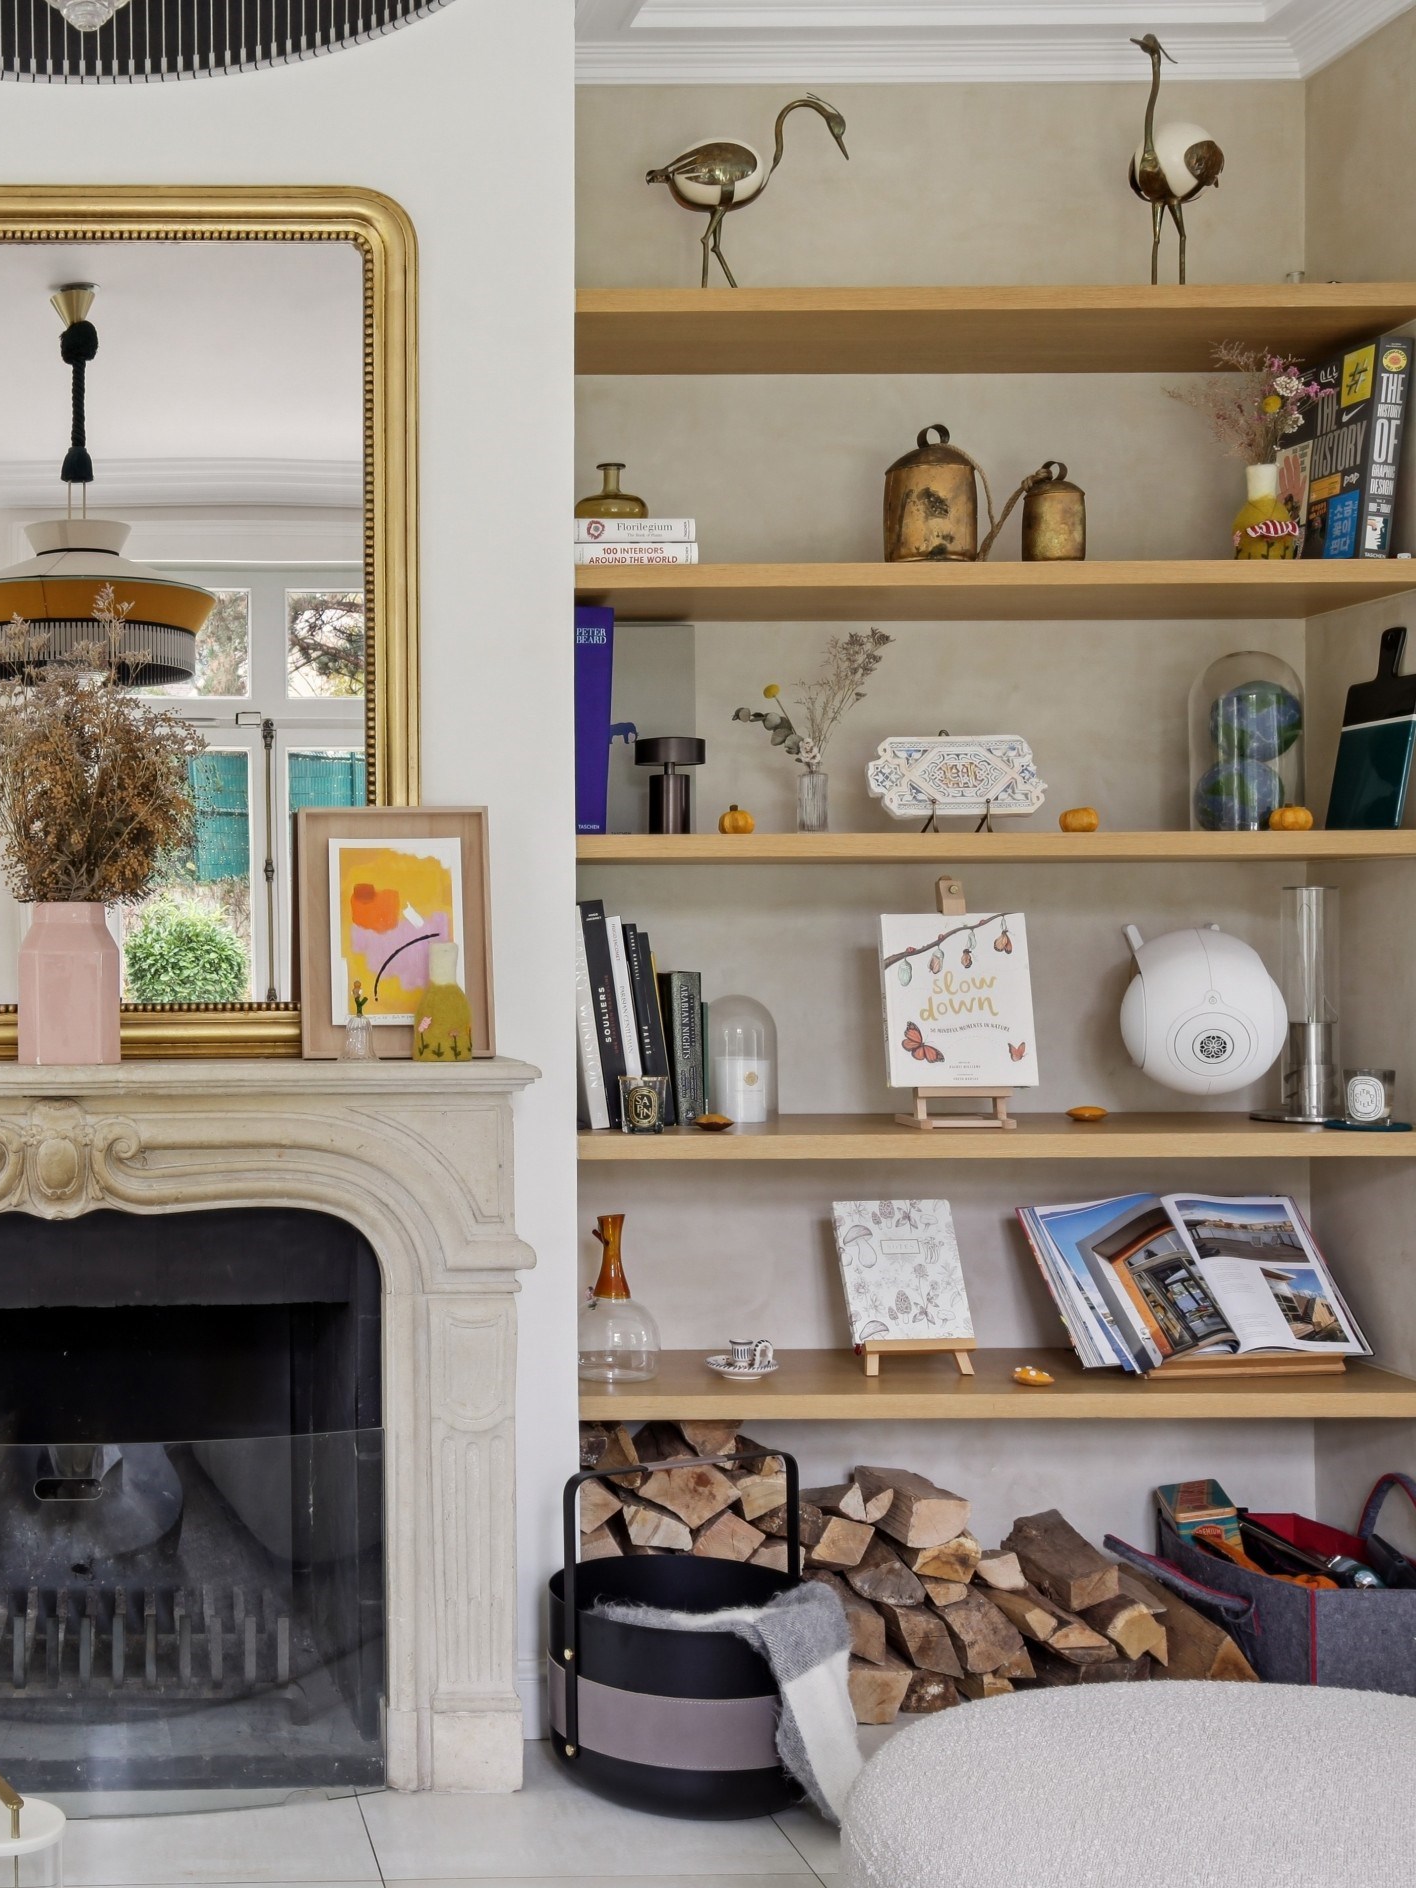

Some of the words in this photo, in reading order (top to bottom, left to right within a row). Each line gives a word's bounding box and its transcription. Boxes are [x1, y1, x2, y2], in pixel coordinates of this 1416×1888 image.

[1380, 373, 1406, 404] THE
[1377, 403, 1403, 419] HISTORY
[1311, 420, 1367, 481] HISTORY
[1373, 418, 1401, 464] OF
[1371, 463, 1396, 479] GRAPHIC
[1369, 478, 1395, 496] DESIGN
[617, 522, 673, 532] Florilegium
[588, 556, 627, 564] AROUND
[629, 556, 644, 564] THE
[647, 556, 678, 564] WORLD
[602, 547, 618, 555] 100
[620, 547, 664, 555] INTERIORS
[1364, 551, 1386, 559] TASCHEN
[576, 627, 606, 636] PETER
[576, 635, 607, 644] BEARD
[932, 970, 997, 995] slow
[619, 985, 628, 1014] PARISIAN
[680, 984, 690, 1024] ARABIAN
[919, 996, 999, 1022] down
[598, 986, 612, 1043] SOULIERS
[959, 1022, 983, 1032] MOMENTS
[990, 1023, 1010, 1032] NATURE
[580, 1000, 600, 1089] WINSTON
[642, 1025, 652, 1055] PARIS
[682, 1027, 691, 1060] NIGHTS
